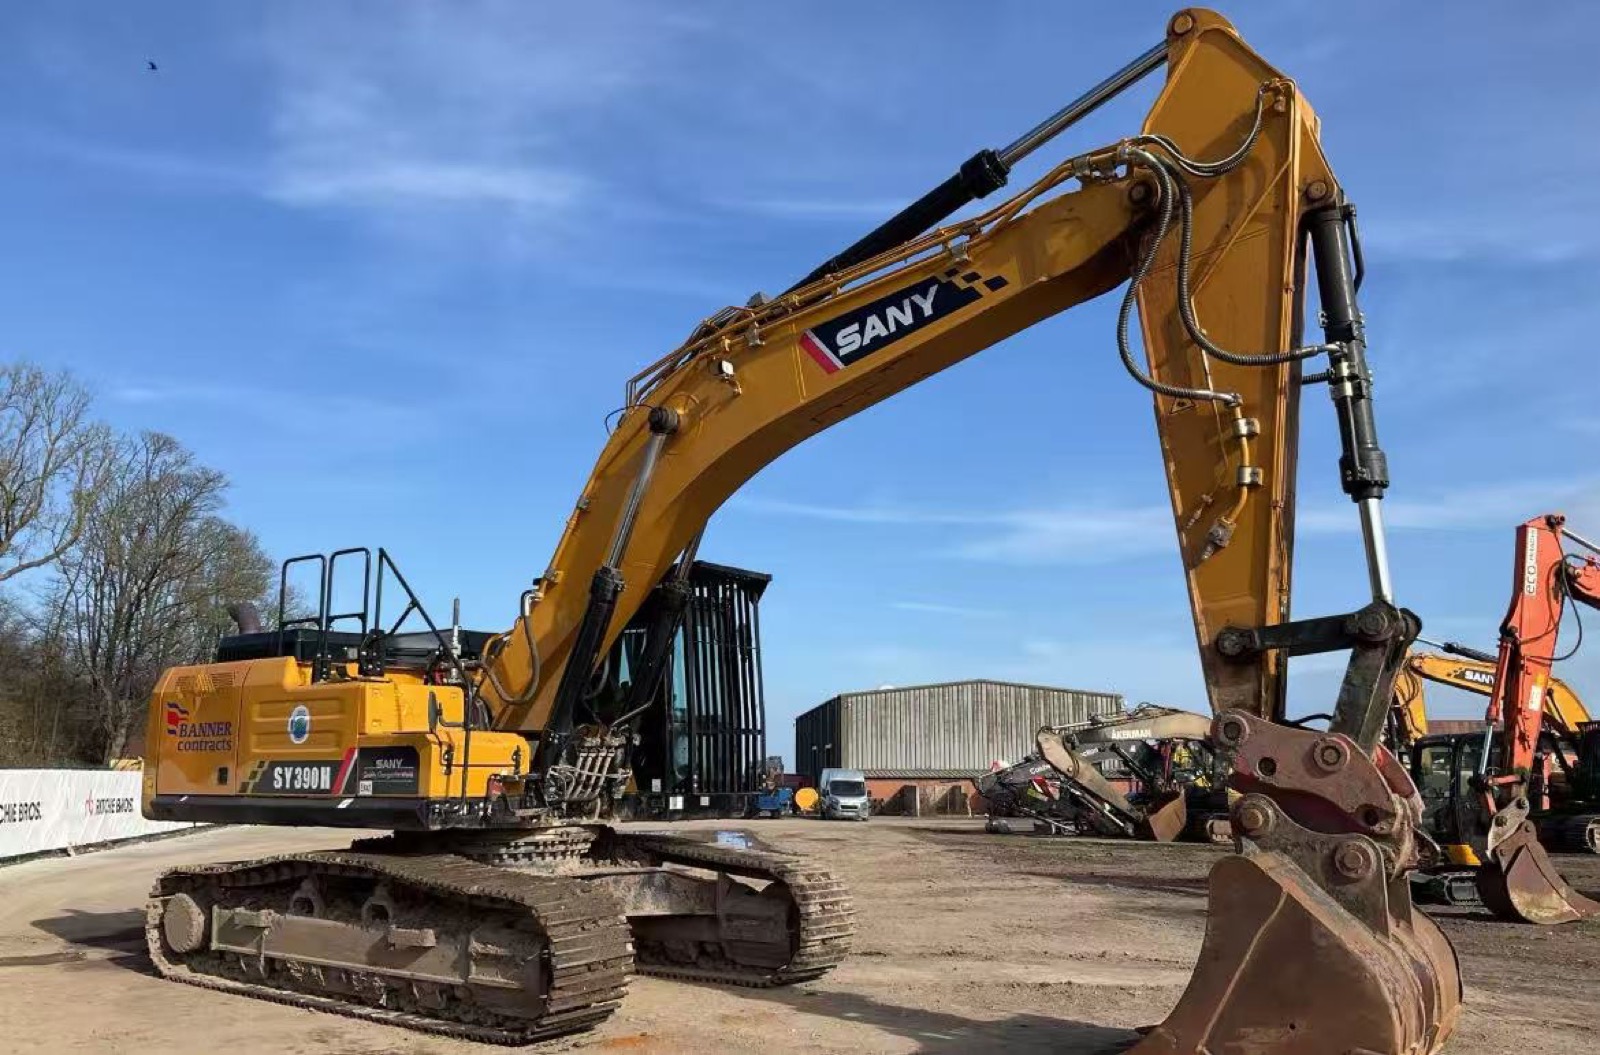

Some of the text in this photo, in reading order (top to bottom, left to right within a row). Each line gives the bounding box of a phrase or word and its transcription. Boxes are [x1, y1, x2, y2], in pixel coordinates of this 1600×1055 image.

[836, 283, 939, 357] SANY
[179, 721, 232, 738] BANNER
[177, 739, 232, 751] contracts
[375, 759, 403, 769] SANY
[273, 766, 331, 790] SY390H
[18, 801, 42, 821] BROS.
[96, 798, 115, 814] RITCHIE
